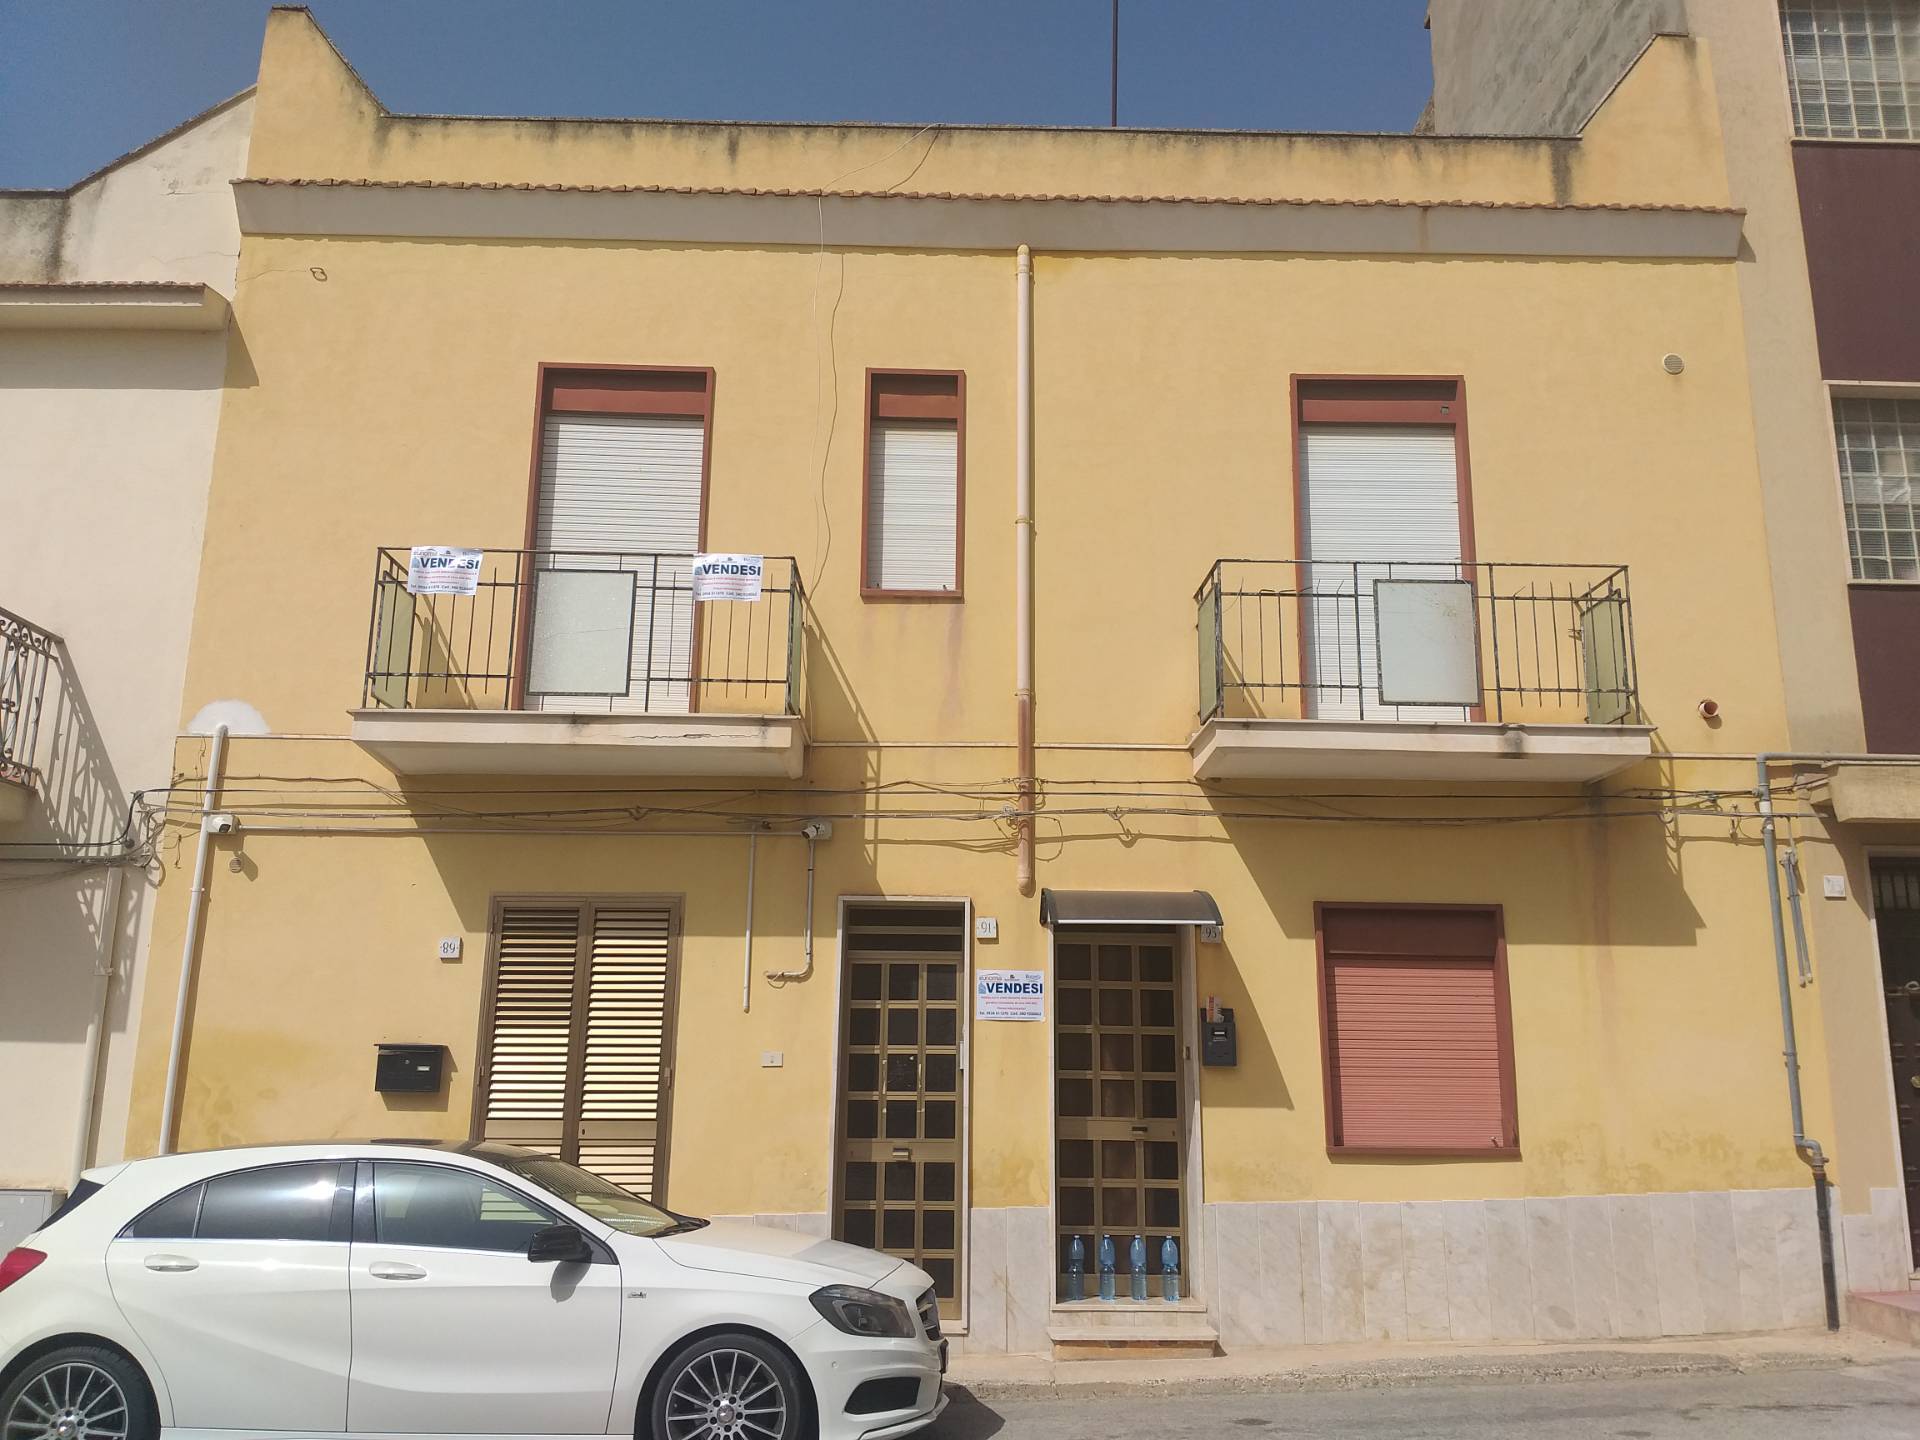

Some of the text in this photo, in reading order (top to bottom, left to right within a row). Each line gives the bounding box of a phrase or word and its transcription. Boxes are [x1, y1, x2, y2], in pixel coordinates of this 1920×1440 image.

[702, 564, 761, 577] VENDESI
[981, 921, 991, 934] 91
[443, 941, 456, 953] 89
[986, 982, 1043, 994] VENDESI
